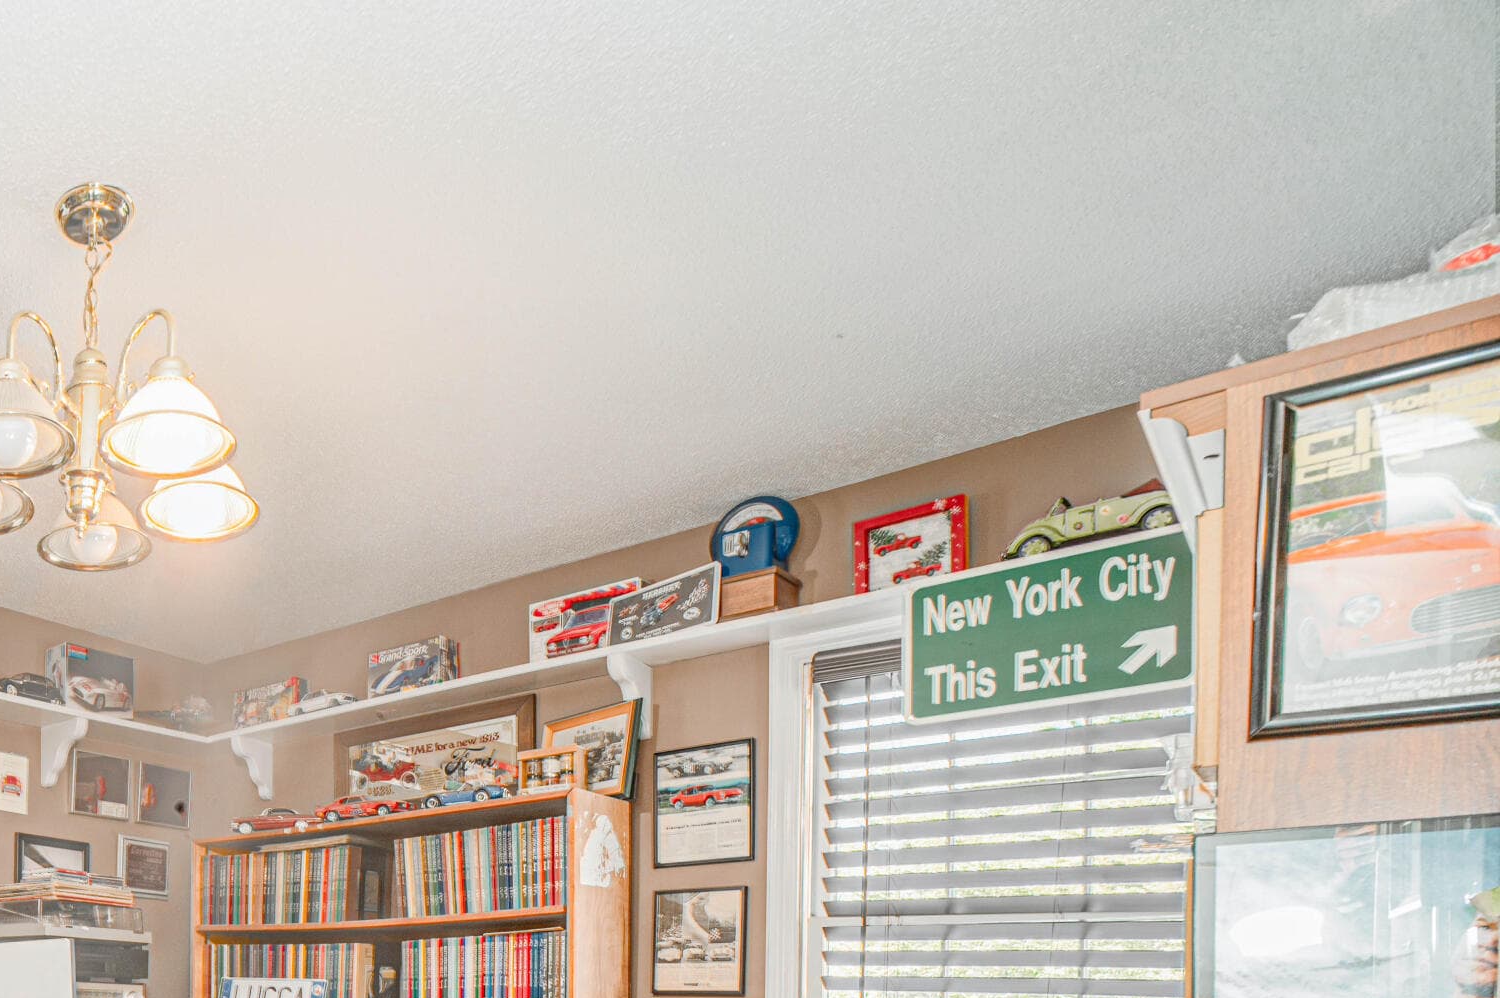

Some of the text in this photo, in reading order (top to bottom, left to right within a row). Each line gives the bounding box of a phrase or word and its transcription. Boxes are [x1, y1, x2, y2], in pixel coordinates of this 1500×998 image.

[923, 555, 1175, 637] New York City
[924, 642, 1087, 705] This Exit
[405, 742, 433, 757] TIME
[435, 742, 447, 751] for
[449, 741, 456, 749] a
[456, 737, 477, 748] new
[442, 746, 496, 774] Ford
